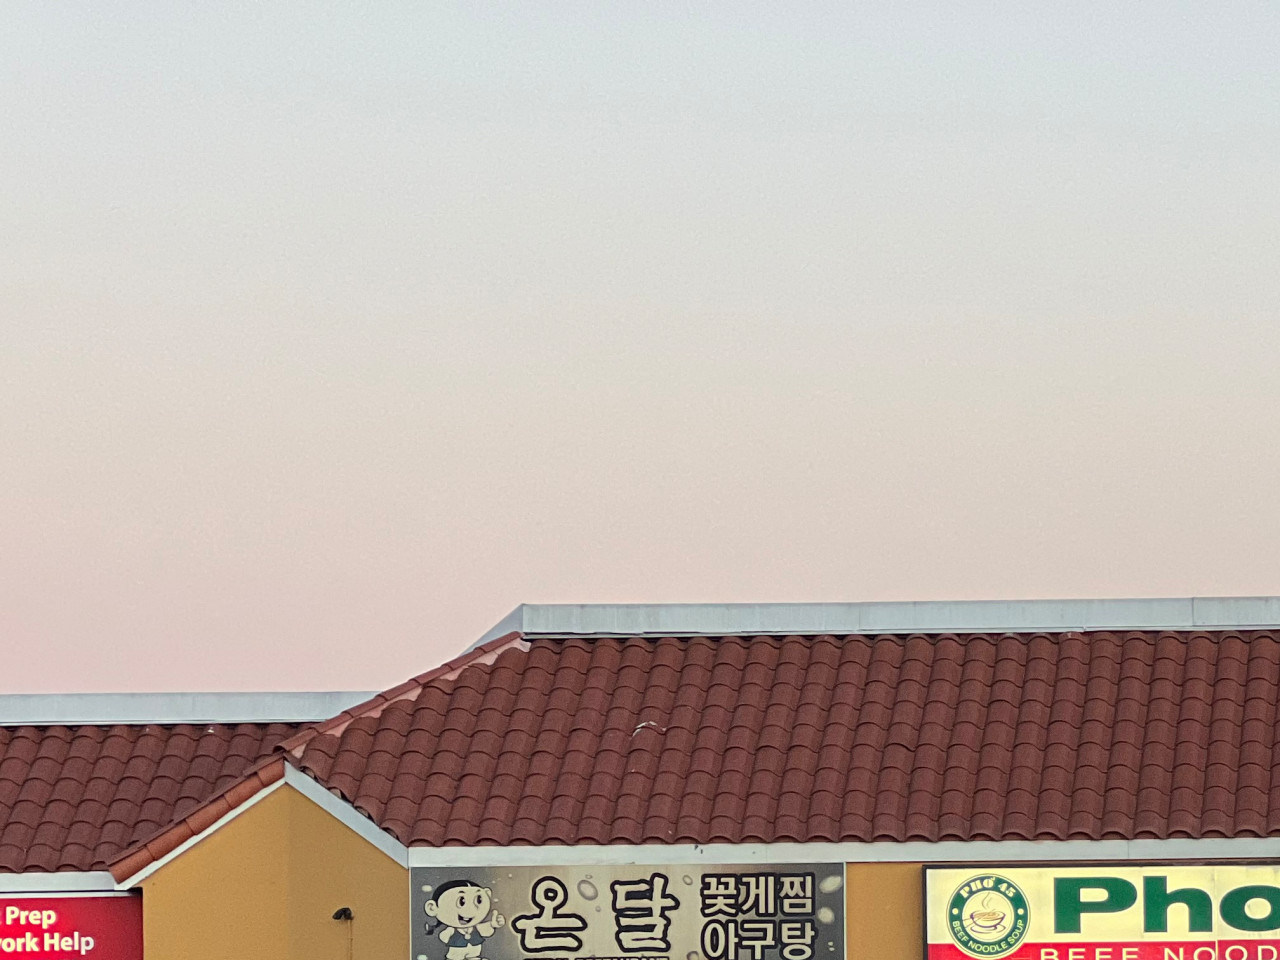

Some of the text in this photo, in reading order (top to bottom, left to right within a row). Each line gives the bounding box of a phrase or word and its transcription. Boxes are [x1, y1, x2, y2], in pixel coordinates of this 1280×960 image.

[702, 873, 815, 917] 꽃게찜
[998, 883, 1016, 897] 45
[5, 906, 57, 929] Prep
[513, 872, 680, 953] 온달
[0, 931, 95, 955] ork Help
[952, 919, 1025, 953] BEEF NOODLE SOUP
